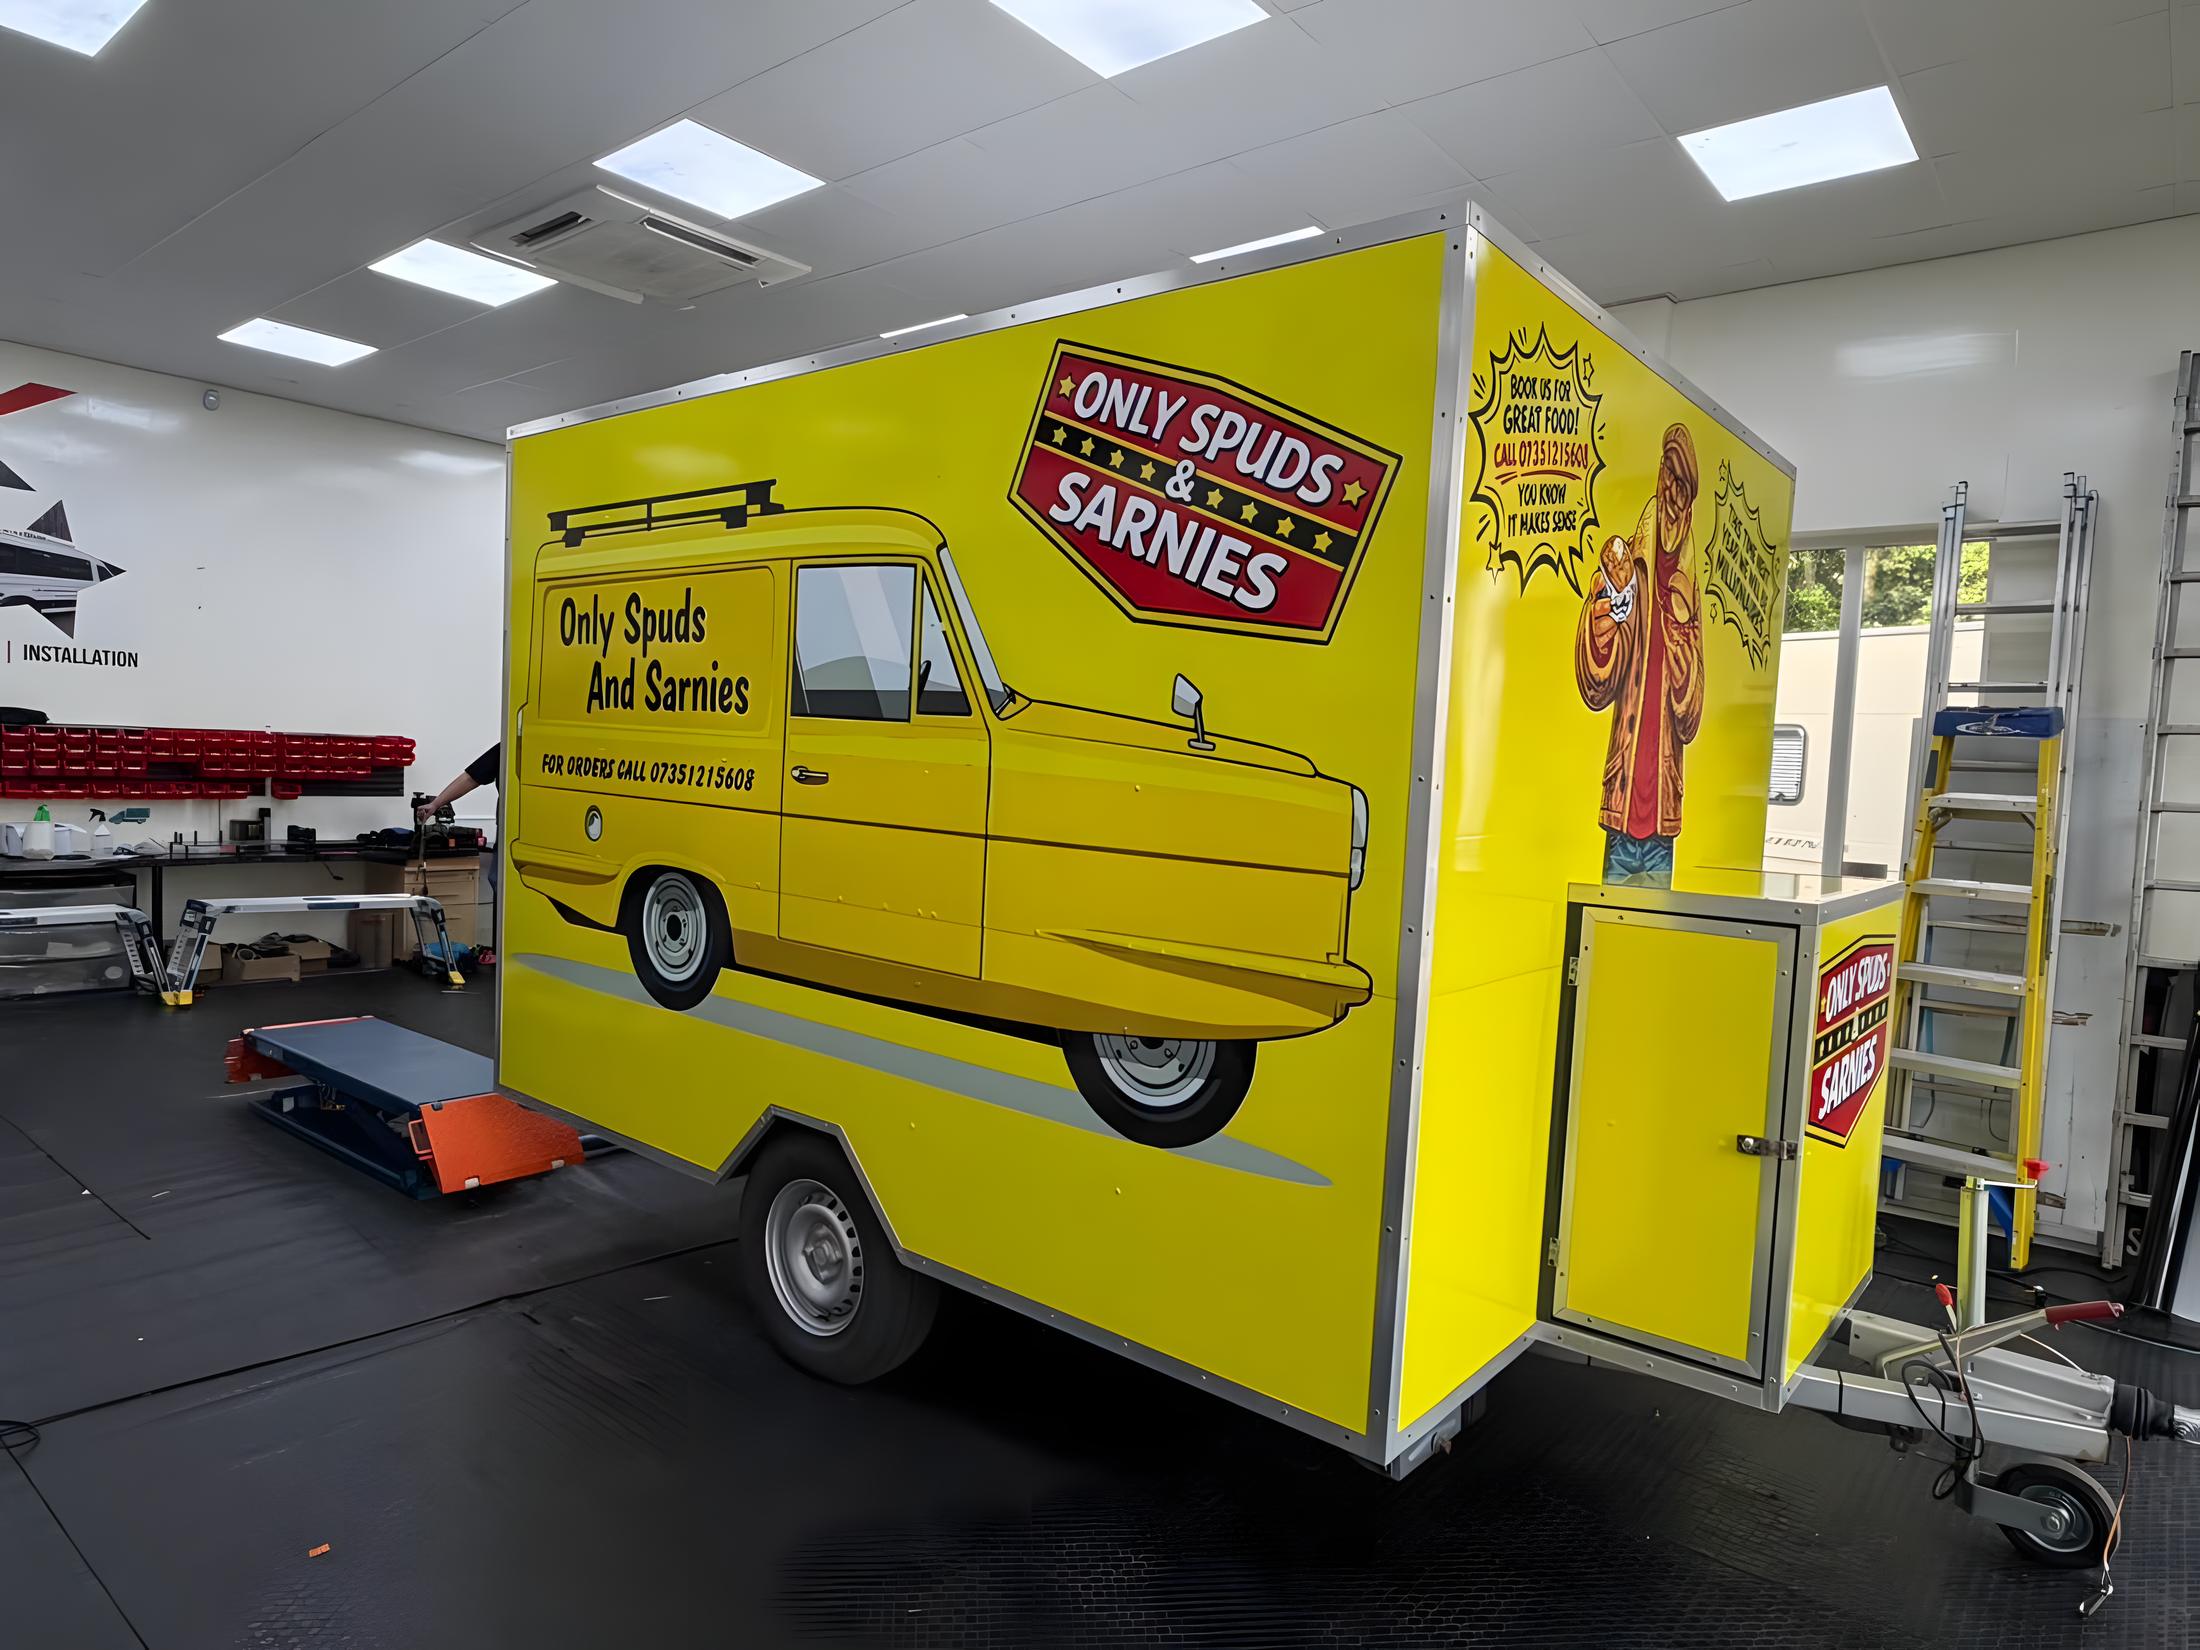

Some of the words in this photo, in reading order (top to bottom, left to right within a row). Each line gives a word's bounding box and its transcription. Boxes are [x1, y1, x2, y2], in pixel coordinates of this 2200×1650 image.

[1510, 373, 1538, 400] BOOK
[1540, 377, 1551, 401] US
[1553, 378, 1571, 401] FOR
[1073, 371, 1187, 441] ONLY
[1178, 403, 1344, 504] SPUDS
[1503, 404, 1542, 434] GREAT
[1545, 407, 1580, 435] FOOD!
[1494, 442, 1517, 468] CALL
[1164, 459, 1197, 502] &
[1049, 471, 1288, 610] SARNIES
[1508, 513, 1518, 538] IT
[560, 593, 615, 659] Only
[624, 587, 707, 658] Spuds
[22, 643, 138, 668] INSTALLATION
[586, 657, 636, 714] And
[644, 659, 750, 715] Sarnies
[541, 753, 564, 776] FOR
[567, 756, 615, 780] ORDERS
[617, 759, 646, 782] CALL
[650, 762, 755, 791] 07351215608
[1825, 962, 1858, 1023] ONLY
[1855, 952, 1889, 1001] SPUDS
[1818, 1034, 1878, 1120] SARNIES
